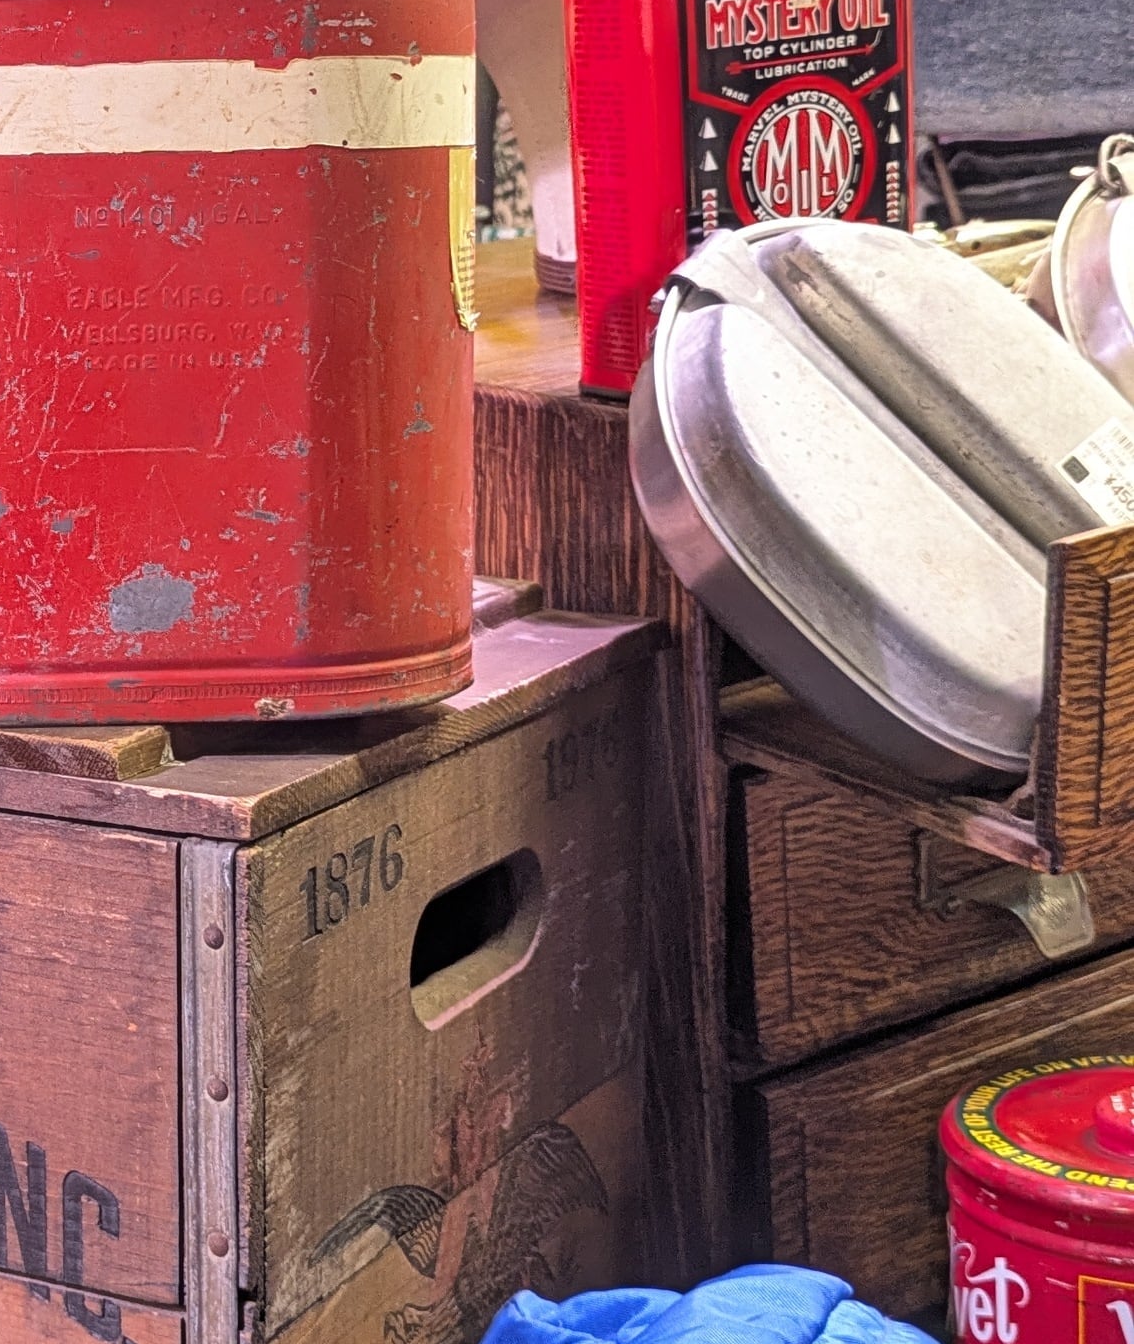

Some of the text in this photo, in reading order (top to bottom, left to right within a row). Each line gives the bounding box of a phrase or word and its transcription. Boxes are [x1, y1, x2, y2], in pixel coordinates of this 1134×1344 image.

[743, 35, 857, 60] TOP CYLINDER
[755, 57, 848, 79] LUBRICATION
[852, 68, 876, 86] MARK
[721, 86, 749, 103] TRADE
[741, 90, 863, 172] MARVEL MYSTERY OIL
[67, 286, 149, 310] EAGLE
[298, 823, 405, 942] 1876
[990, 1068, 1037, 1087] LIFE
[963, 1085, 1001, 1112] YOUR
[962, 1113, 989, 1127] OF
[969, 1129, 1020, 1158] REST
[1010, 1154, 1062, 1176] THE
